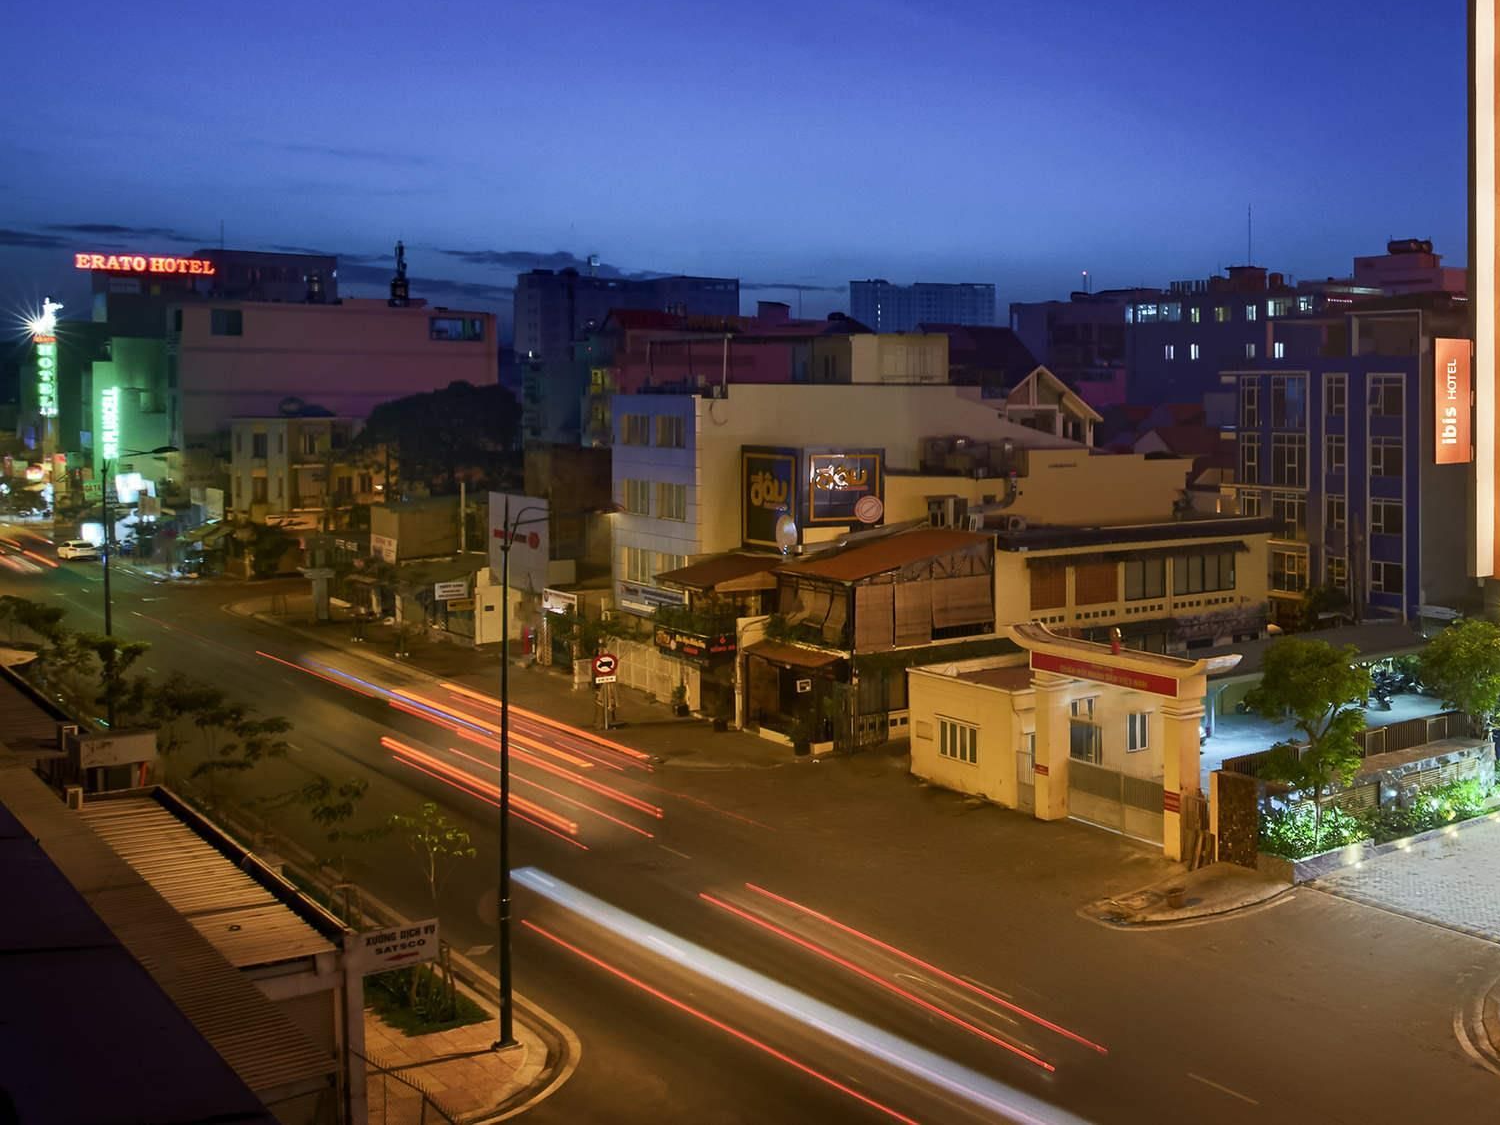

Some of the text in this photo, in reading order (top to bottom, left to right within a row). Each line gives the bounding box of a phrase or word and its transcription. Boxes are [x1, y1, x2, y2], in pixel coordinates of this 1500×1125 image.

[75, 254, 215, 275] ERATO HOTEL
[1442, 358, 1457, 445] ibis HOTEL
